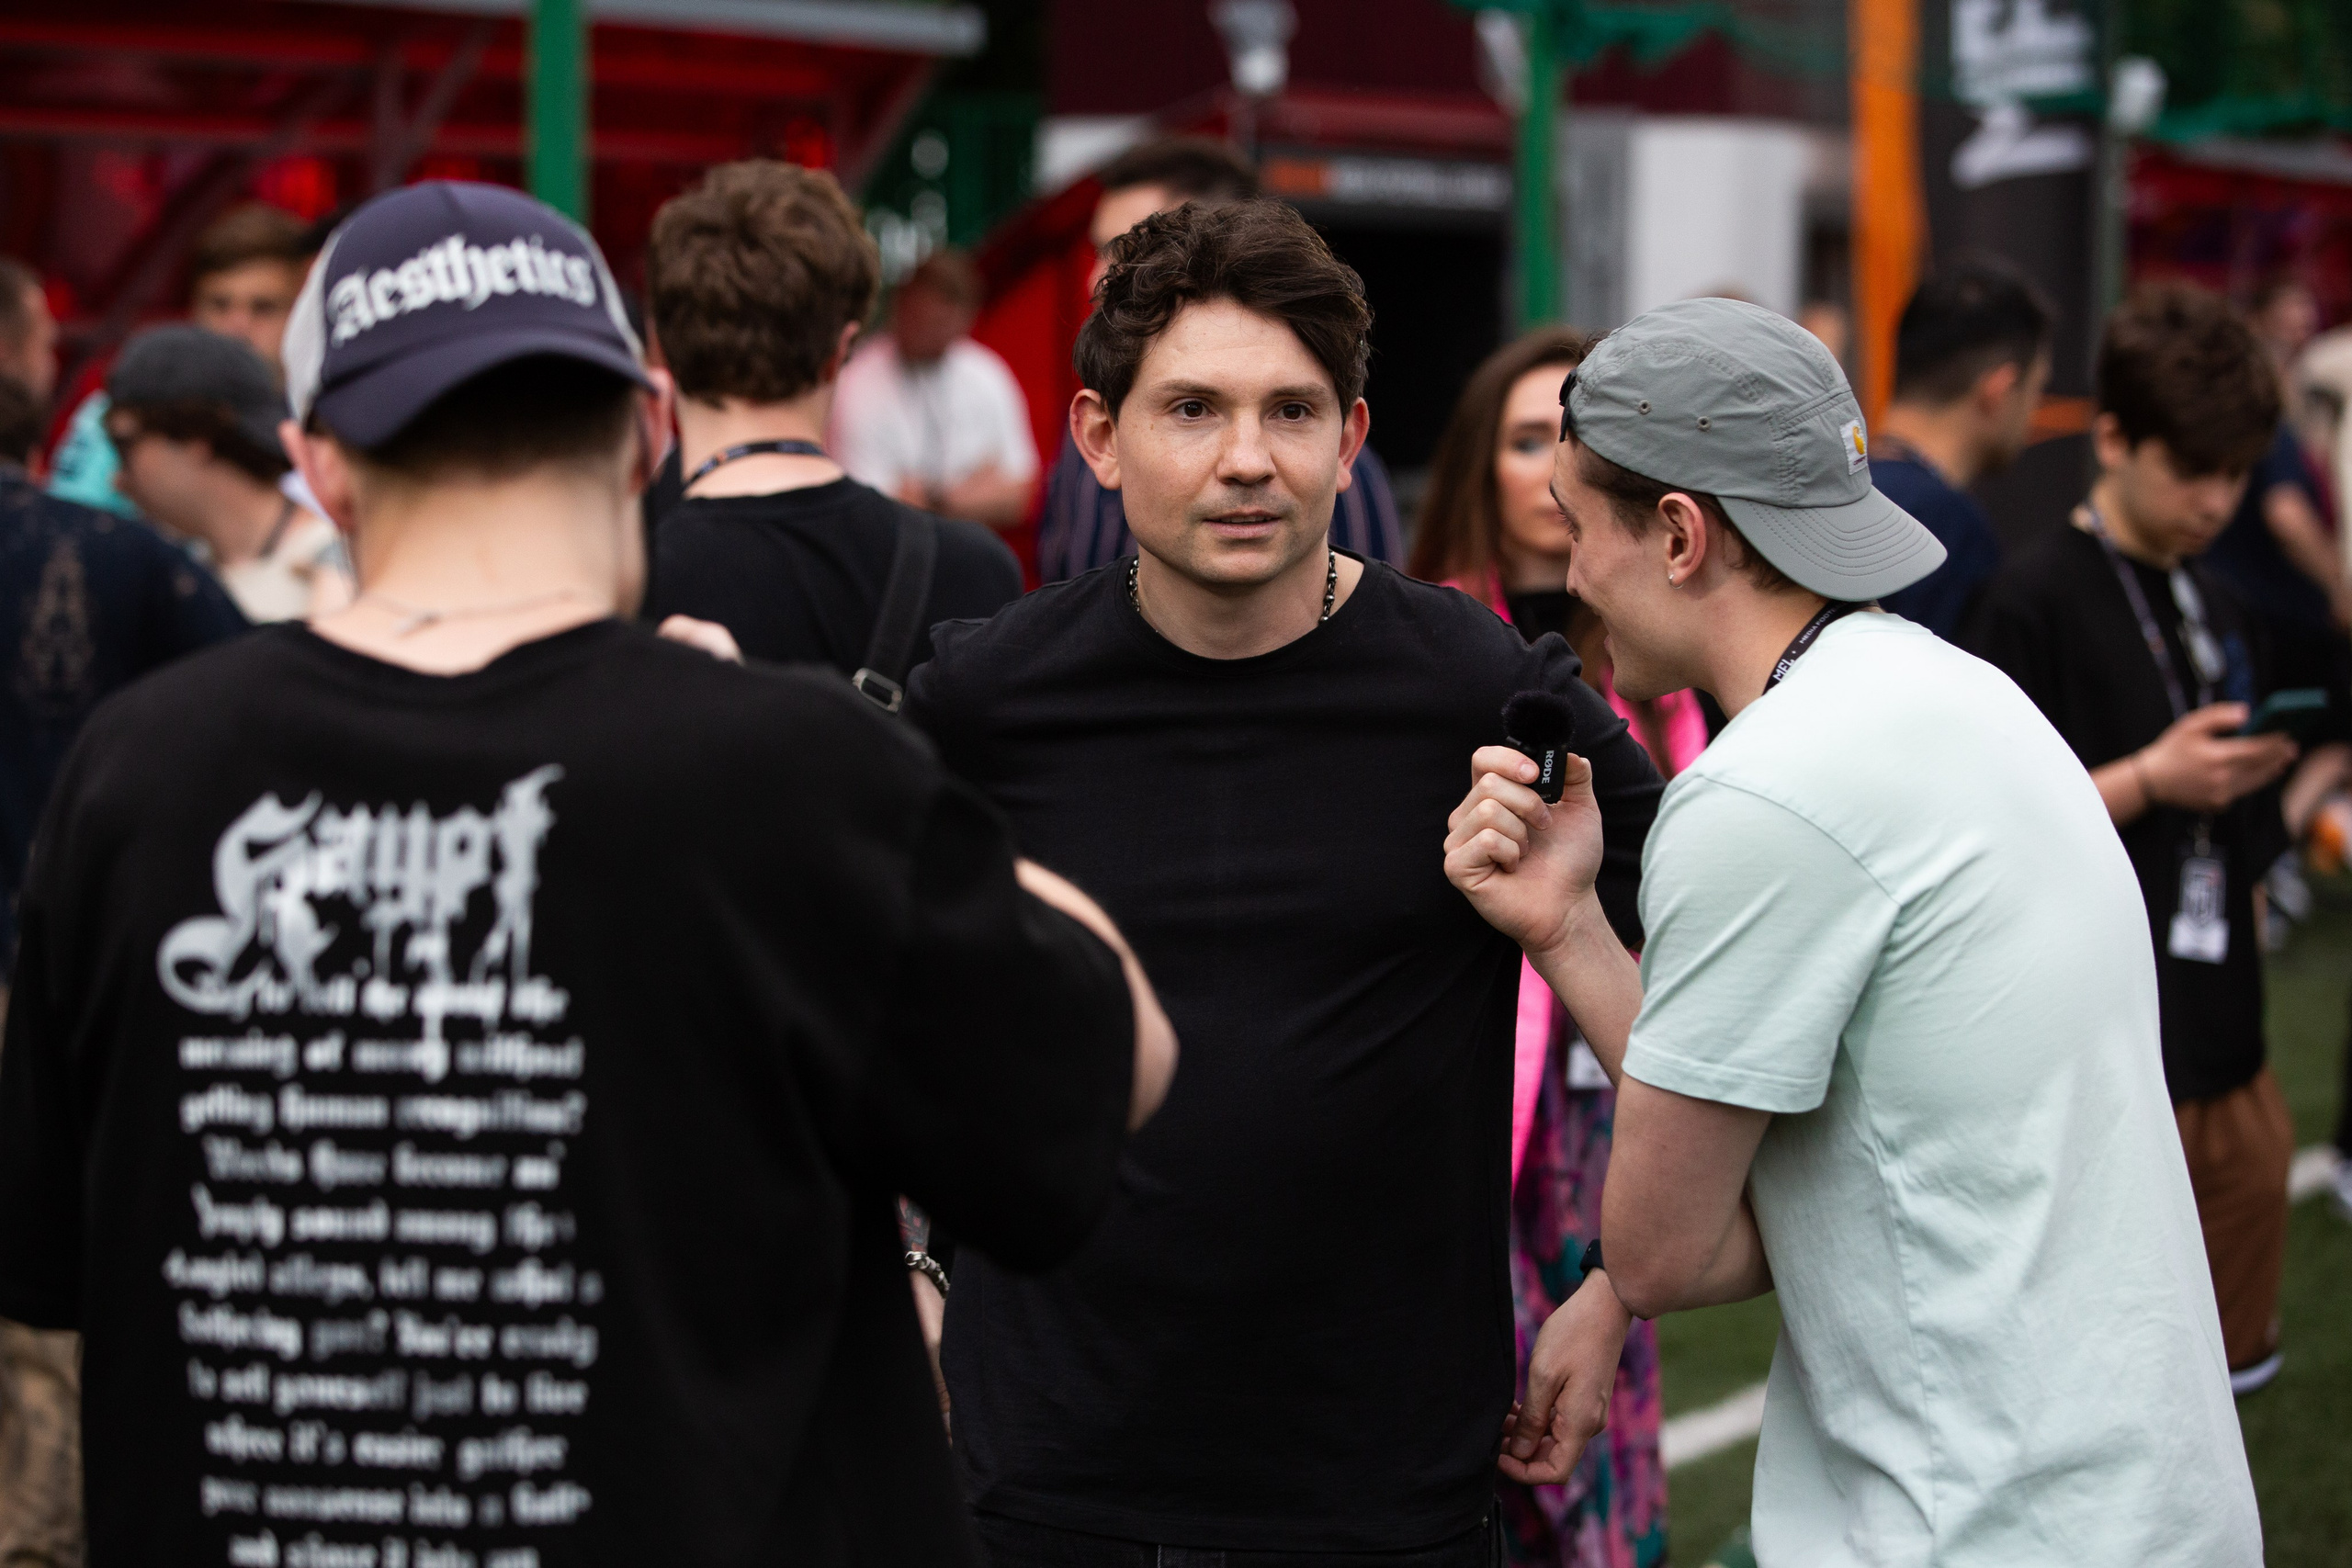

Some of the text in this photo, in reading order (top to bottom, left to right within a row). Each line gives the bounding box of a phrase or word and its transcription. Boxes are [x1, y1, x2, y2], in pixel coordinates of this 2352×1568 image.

[327, 233, 597, 347] Aesthetics
[1772, 659, 1795, 681] MFL
[1799, 626, 1818, 644] MEDIA
[1542, 750, 1555, 784] RØDE
